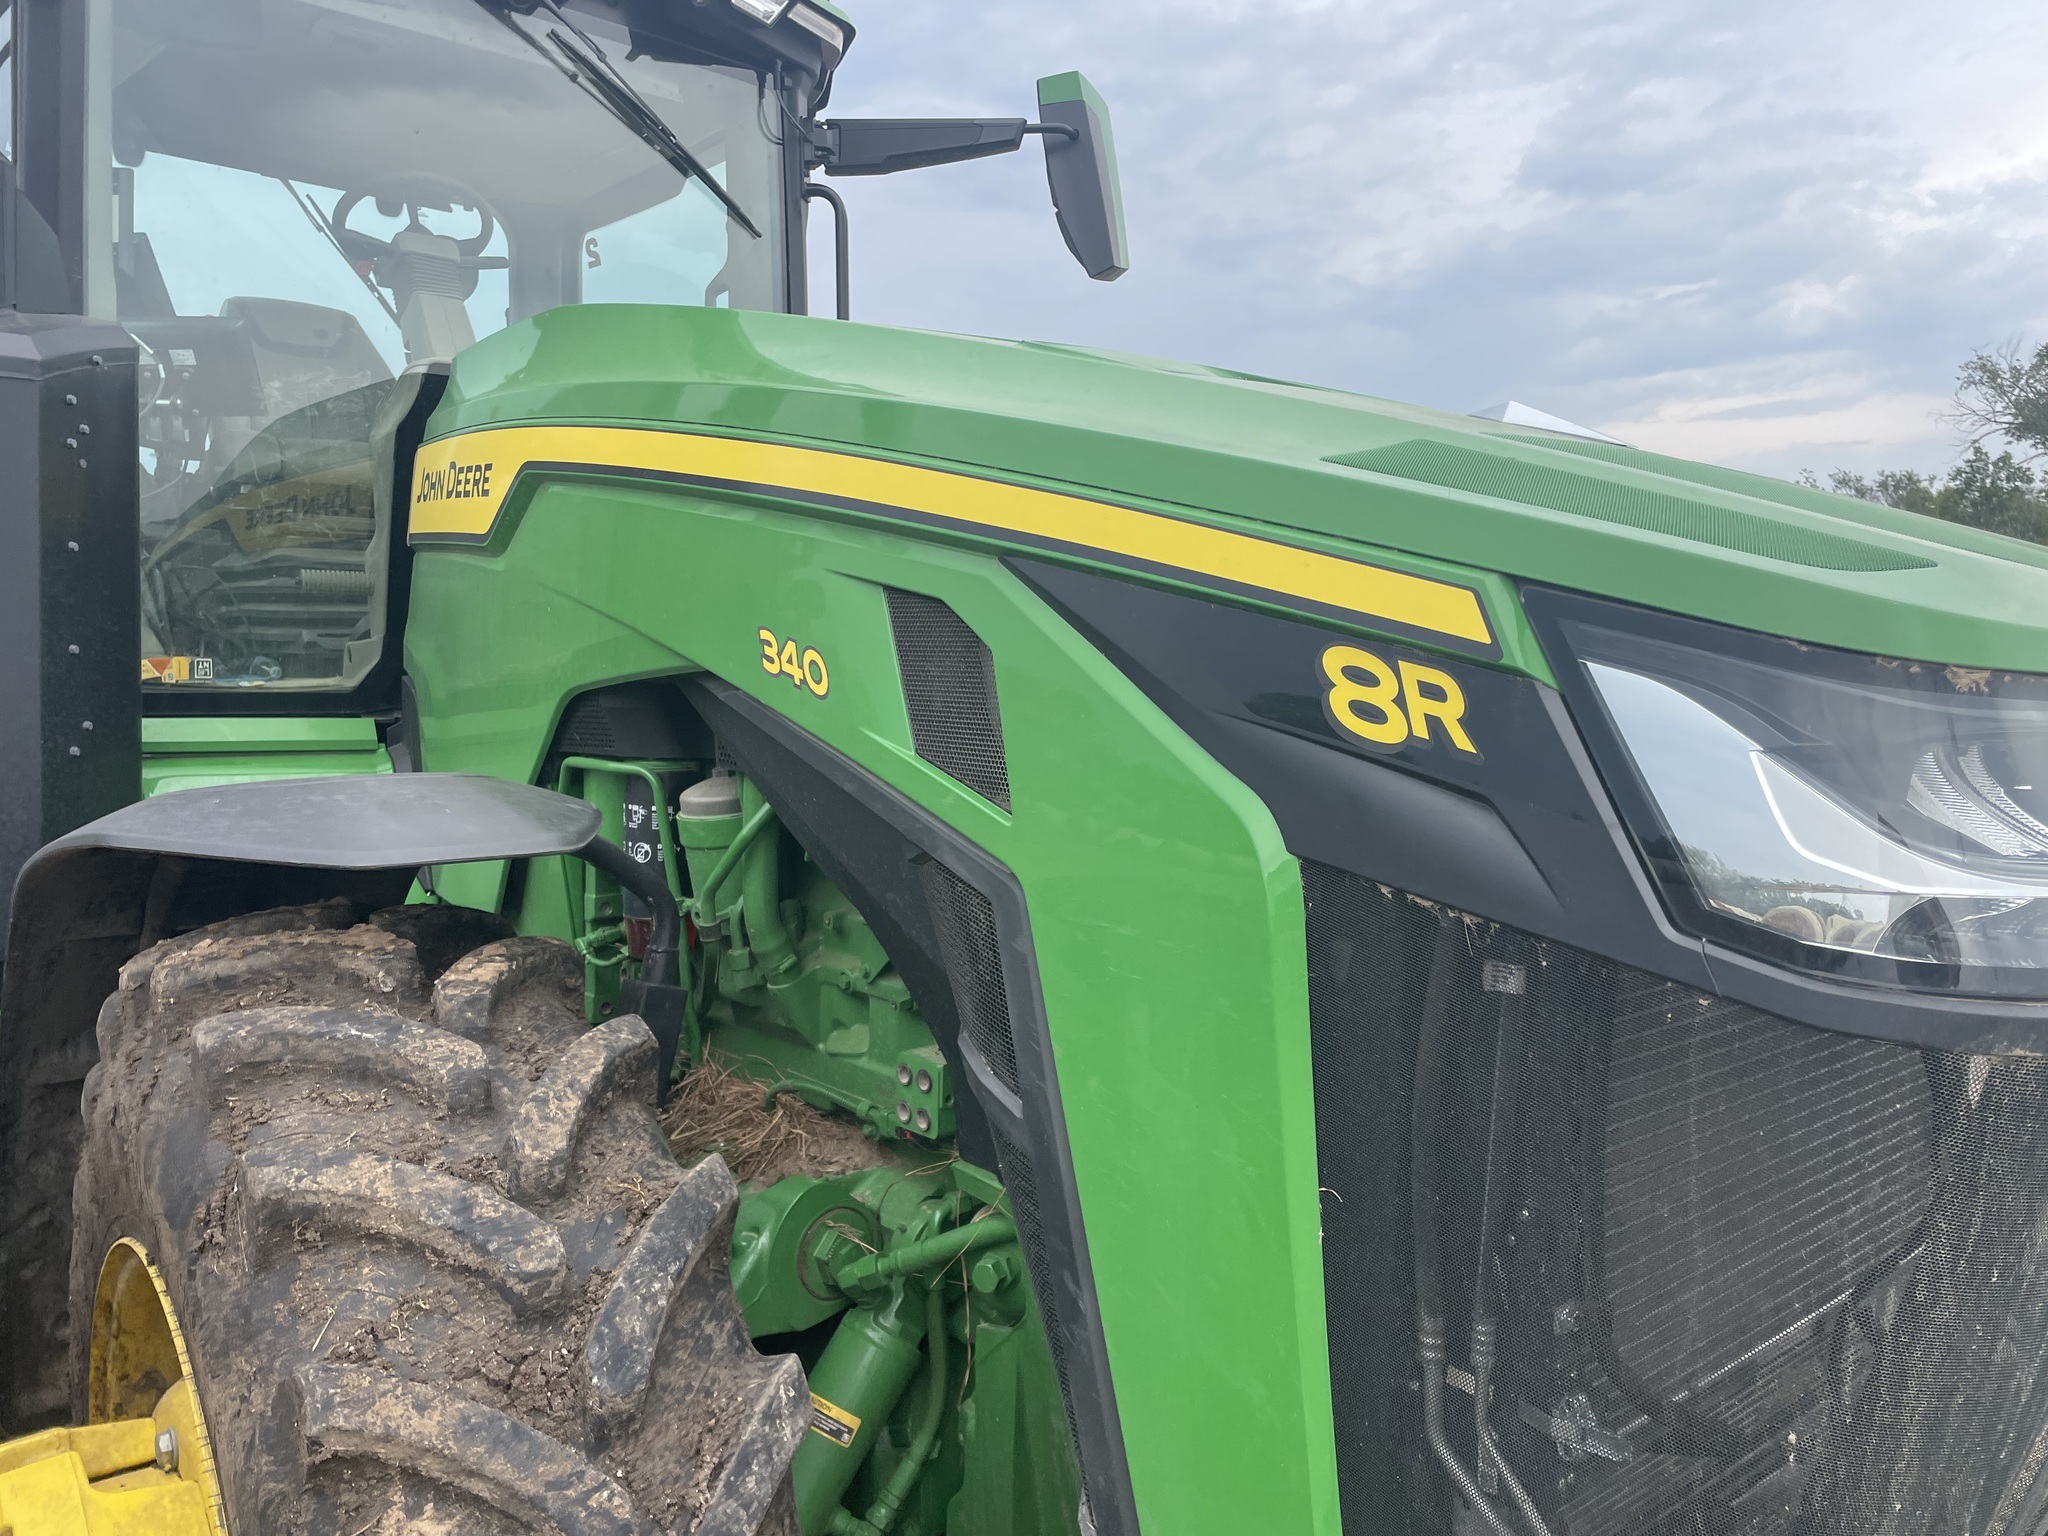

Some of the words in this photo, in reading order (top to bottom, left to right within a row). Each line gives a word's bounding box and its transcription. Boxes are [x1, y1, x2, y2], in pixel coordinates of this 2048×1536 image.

[417, 467, 446, 503] JOHN
[446, 461, 493, 499] DEERE
[759, 628, 829, 696] 340
[1321, 645, 1478, 755] 8R
